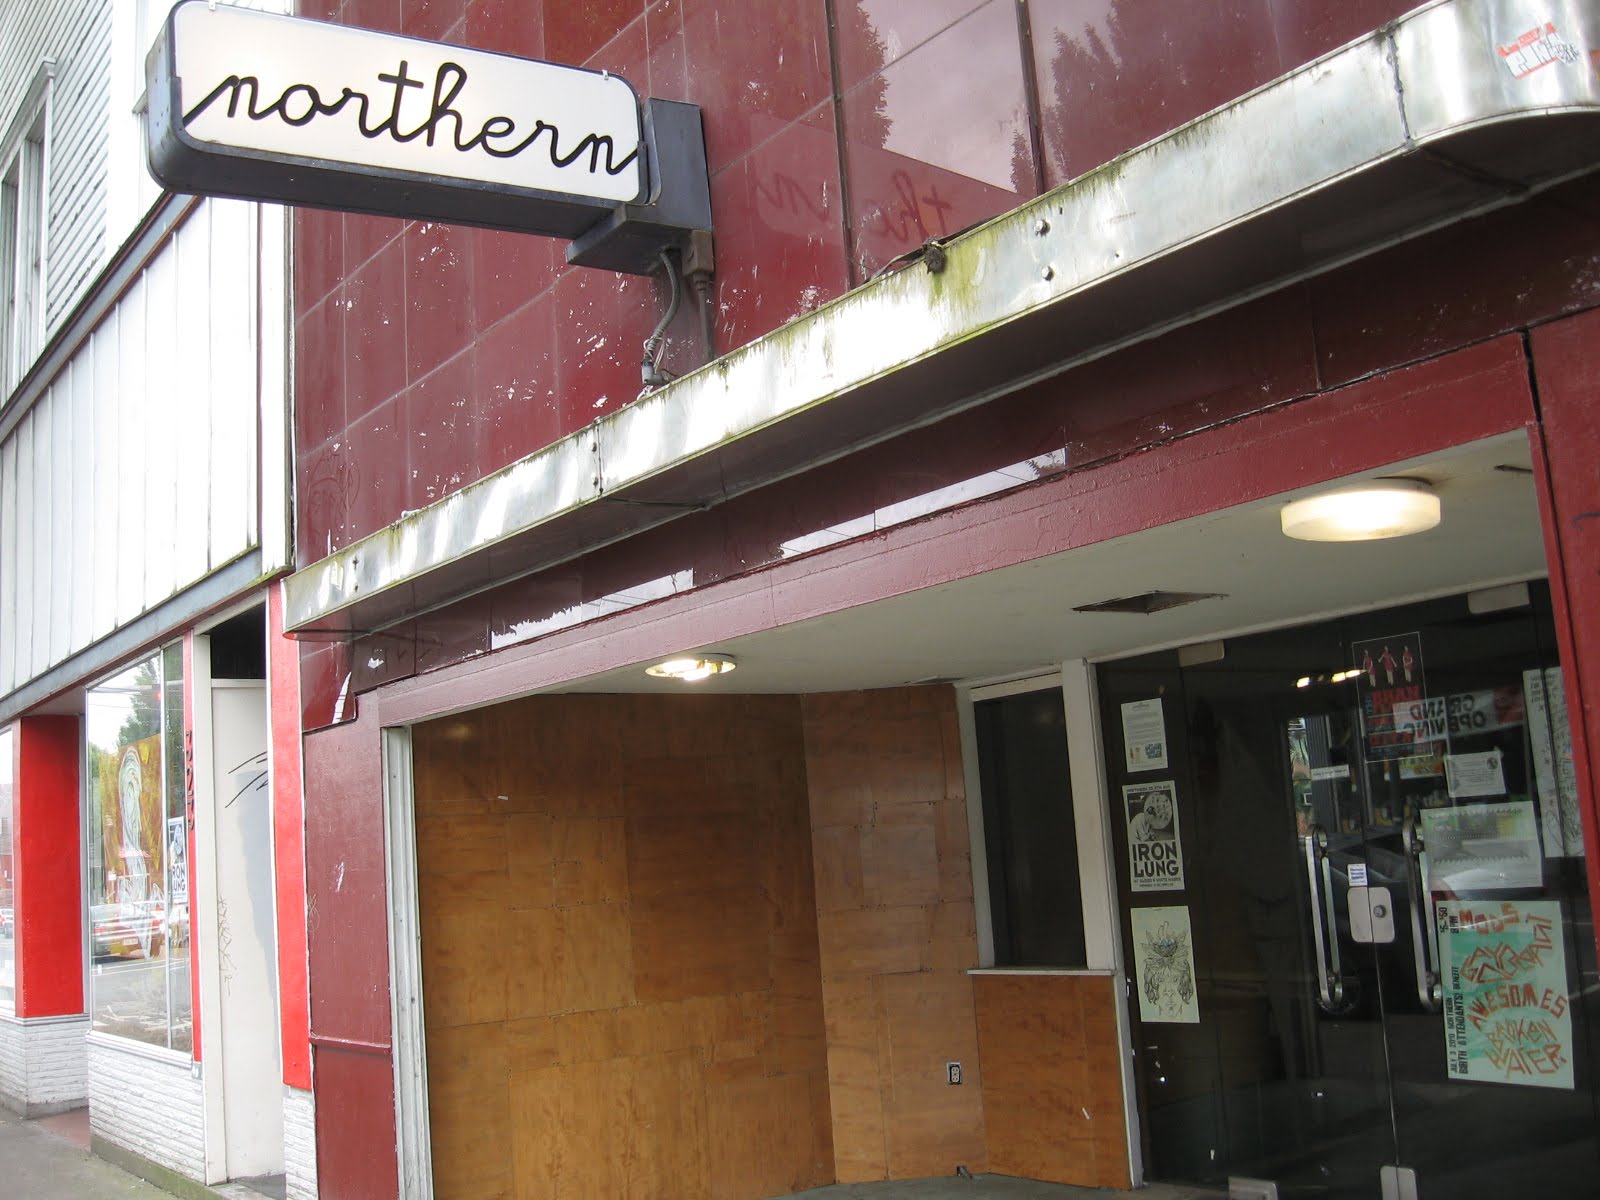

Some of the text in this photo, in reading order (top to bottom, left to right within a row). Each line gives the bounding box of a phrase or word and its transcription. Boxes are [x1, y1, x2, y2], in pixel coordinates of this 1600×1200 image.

[182, 60, 640, 176] northern
[1132, 842, 1178, 861] IRON
[171, 864, 185, 879] RON
[1133, 860, 1179, 878] LUNG
[171, 878, 186, 893] UNG
[1445, 997, 1455, 1029] NORTHERN
[1467, 983, 1568, 1032] AWESOMES
[1458, 1050, 1469, 1075] BIRTH
